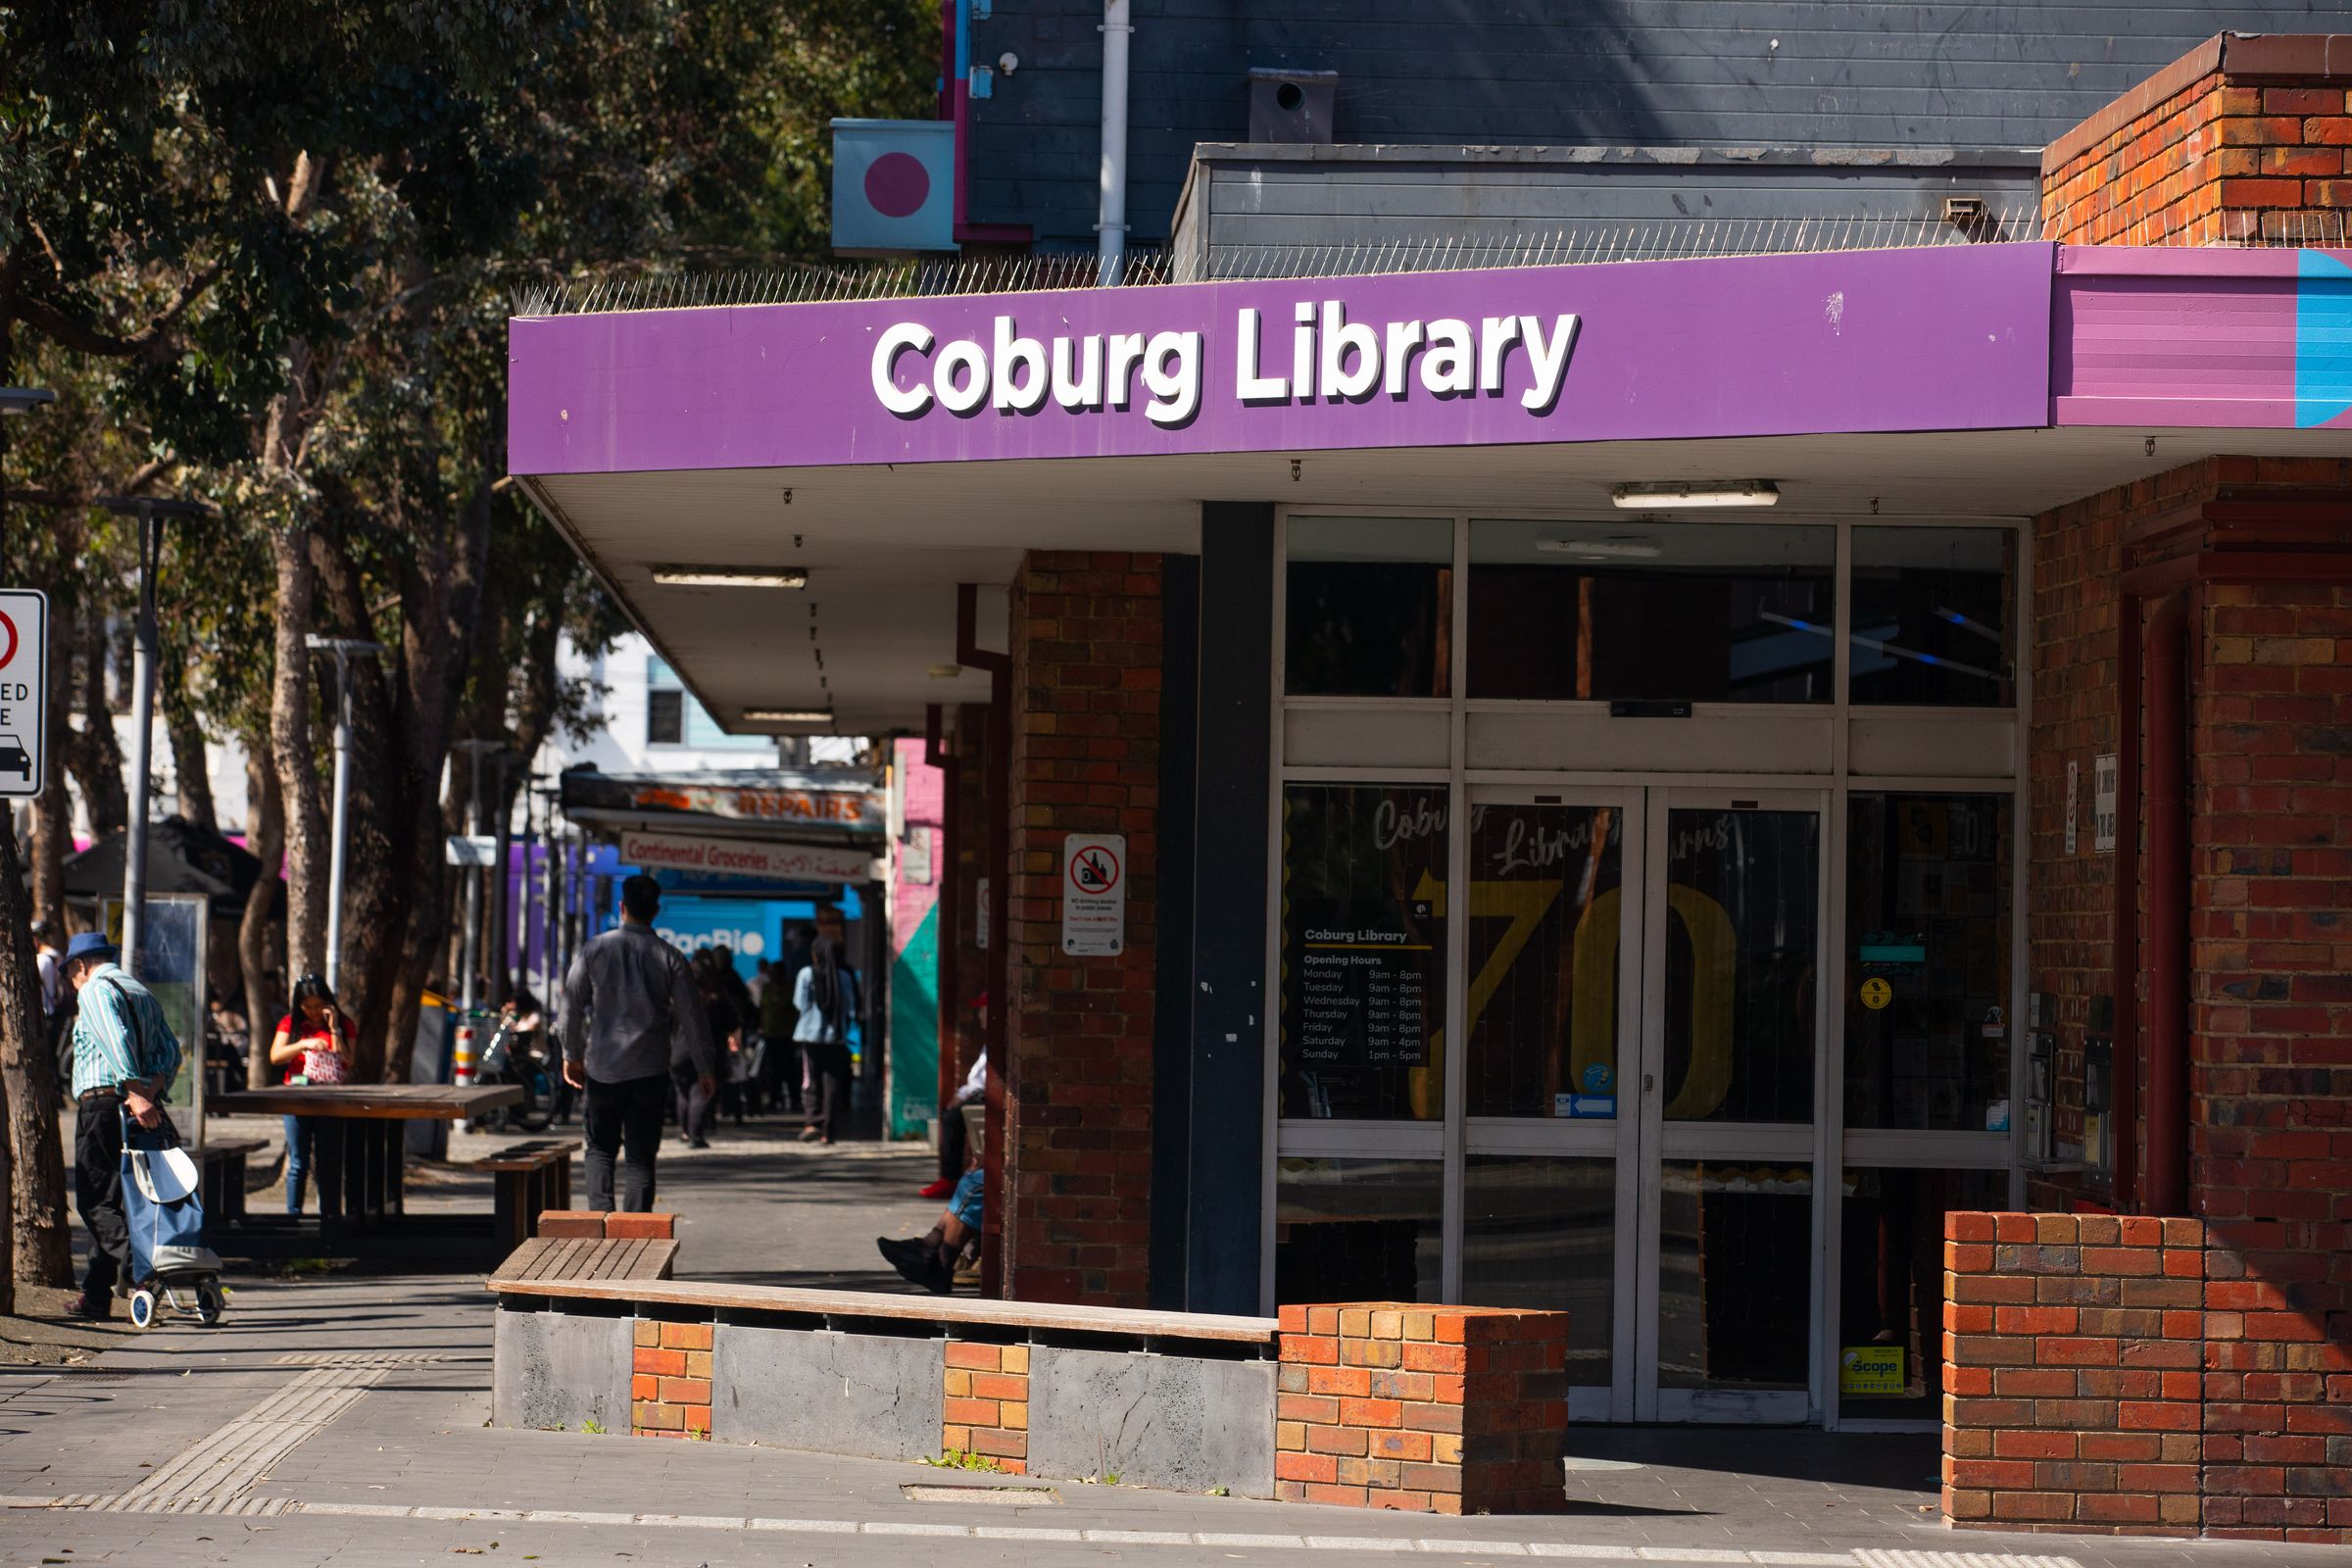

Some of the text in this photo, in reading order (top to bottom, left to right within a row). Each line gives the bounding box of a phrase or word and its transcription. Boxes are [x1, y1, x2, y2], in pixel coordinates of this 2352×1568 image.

[871, 300, 1580, 424] Coburg Library
[738, 791, 863, 820] REPAIRS
[627, 838, 768, 870] Continental Groceries
[1304, 929, 1407, 944] Coburg Library
[1303, 955, 1382, 966] Opening Hours
[1303, 969, 1343, 980] Monday
[1369, 970, 1390, 979] 9am
[1399, 970, 1421, 980] 8pm
[1303, 983, 1344, 993] Tuesday
[1368, 984, 1390, 993] 9am
[1399, 984, 1421, 994] 8pm
[1303, 996, 1360, 1006] Wednesday
[1368, 997, 1390, 1005] 9am
[1399, 998, 1421, 1007] 8pm
[1303, 1009, 1348, 1020] Thursday
[1368, 1010, 1390, 1019] 9am
[1399, 1010, 1421, 1020] 8pm
[1302, 1022, 1333, 1033] Friday
[1399, 1024, 1421, 1034] 8pm
[1302, 1036, 1346, 1047] Saturday
[1368, 1037, 1389, 1046] 9am
[1399, 1038, 1421, 1048] 4pm
[1302, 1050, 1338, 1059] Sunday
[1369, 1051, 1389, 1060] 1pm
[1399, 1051, 1421, 1060] 5pm
